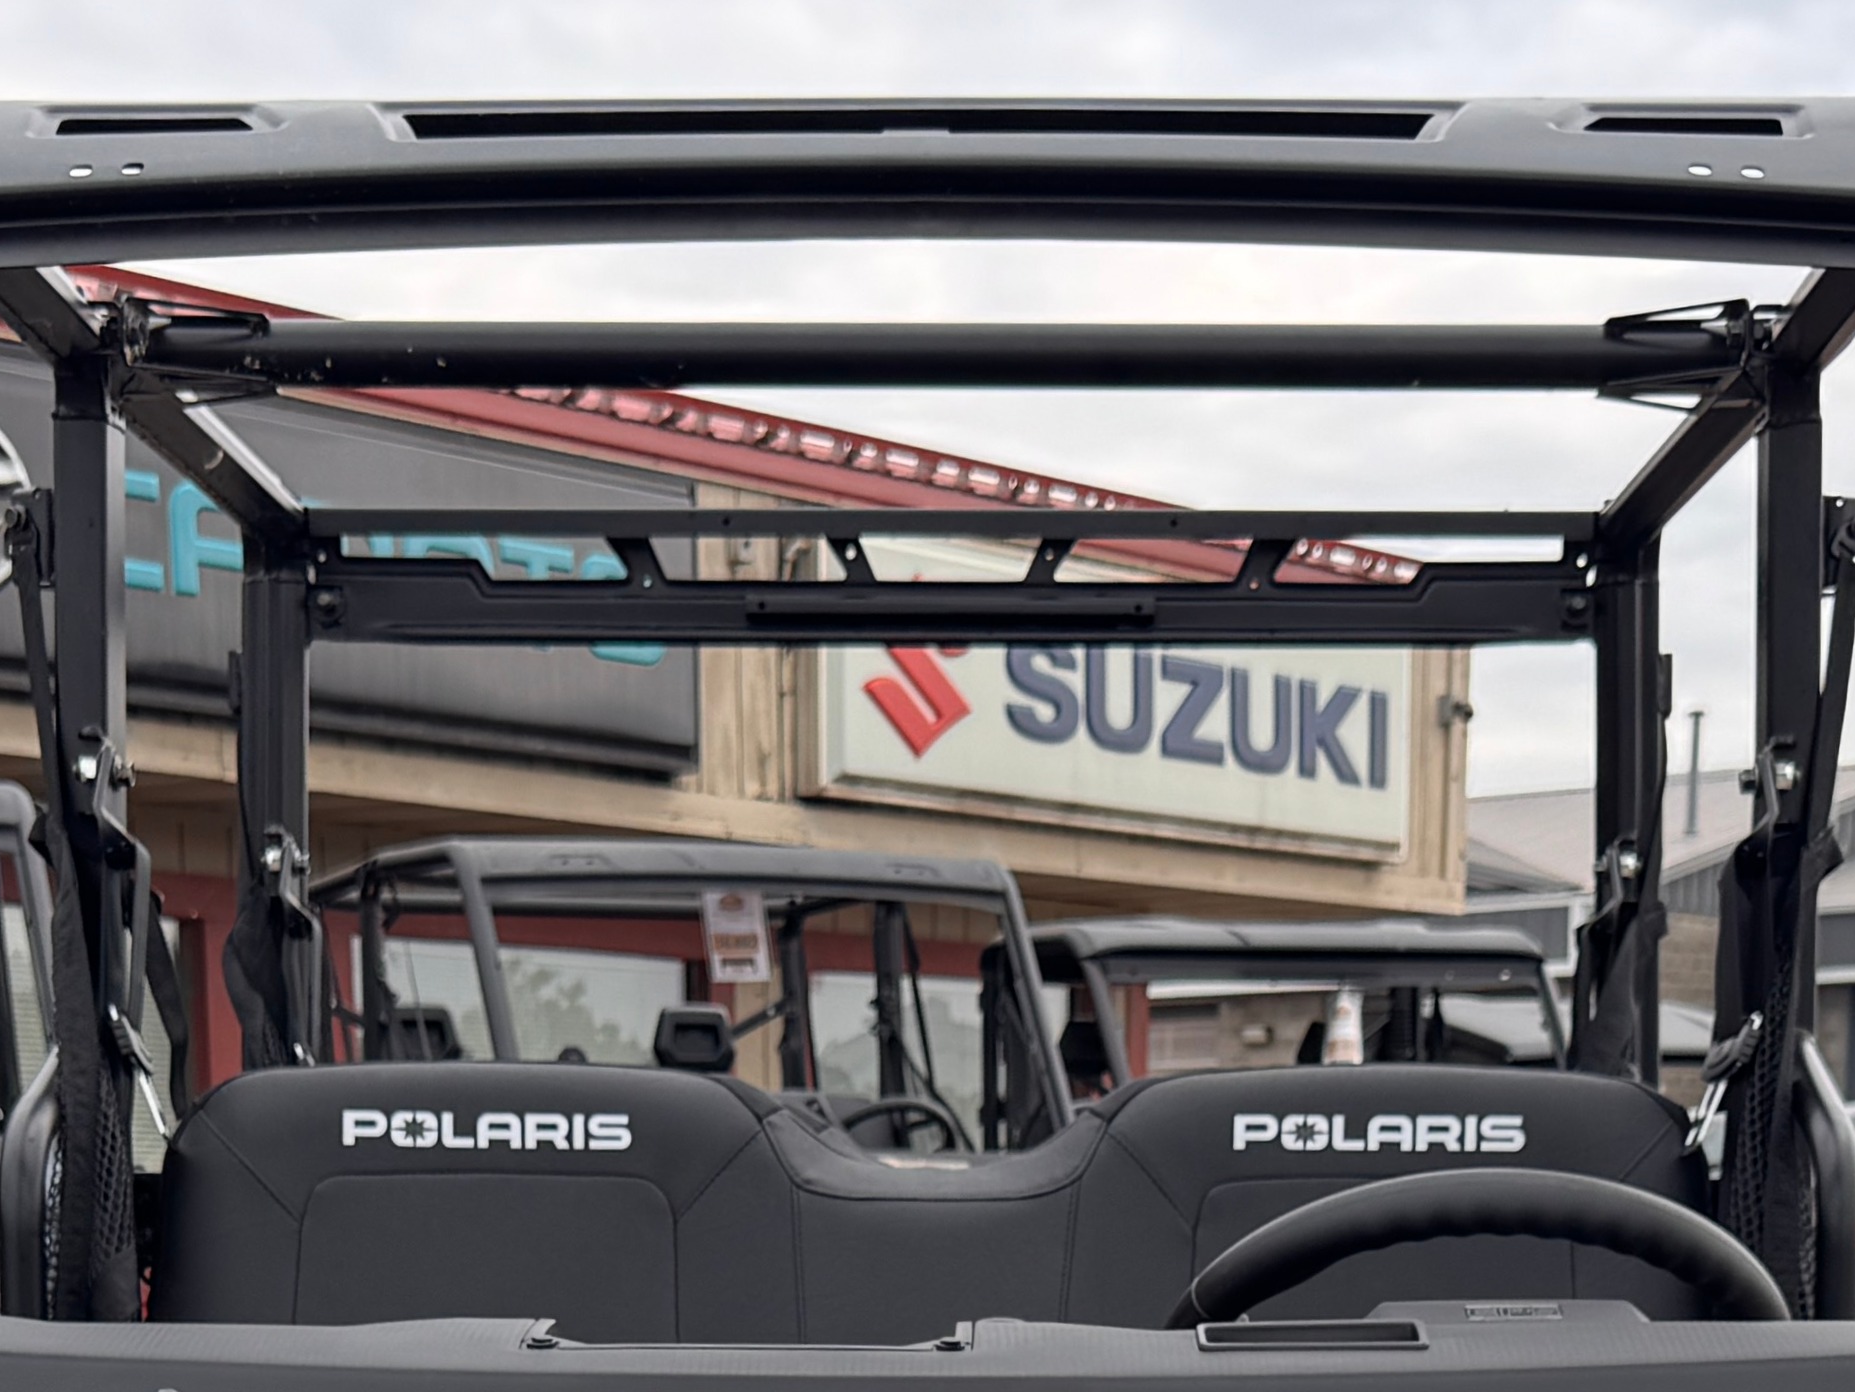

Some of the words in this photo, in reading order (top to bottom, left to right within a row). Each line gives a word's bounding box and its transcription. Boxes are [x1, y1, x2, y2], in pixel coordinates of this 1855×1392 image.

[1005, 643, 1388, 790] SUZUKI
[342, 1109, 633, 1151] POLARIS
[1233, 1113, 1527, 1153] POLARIS
